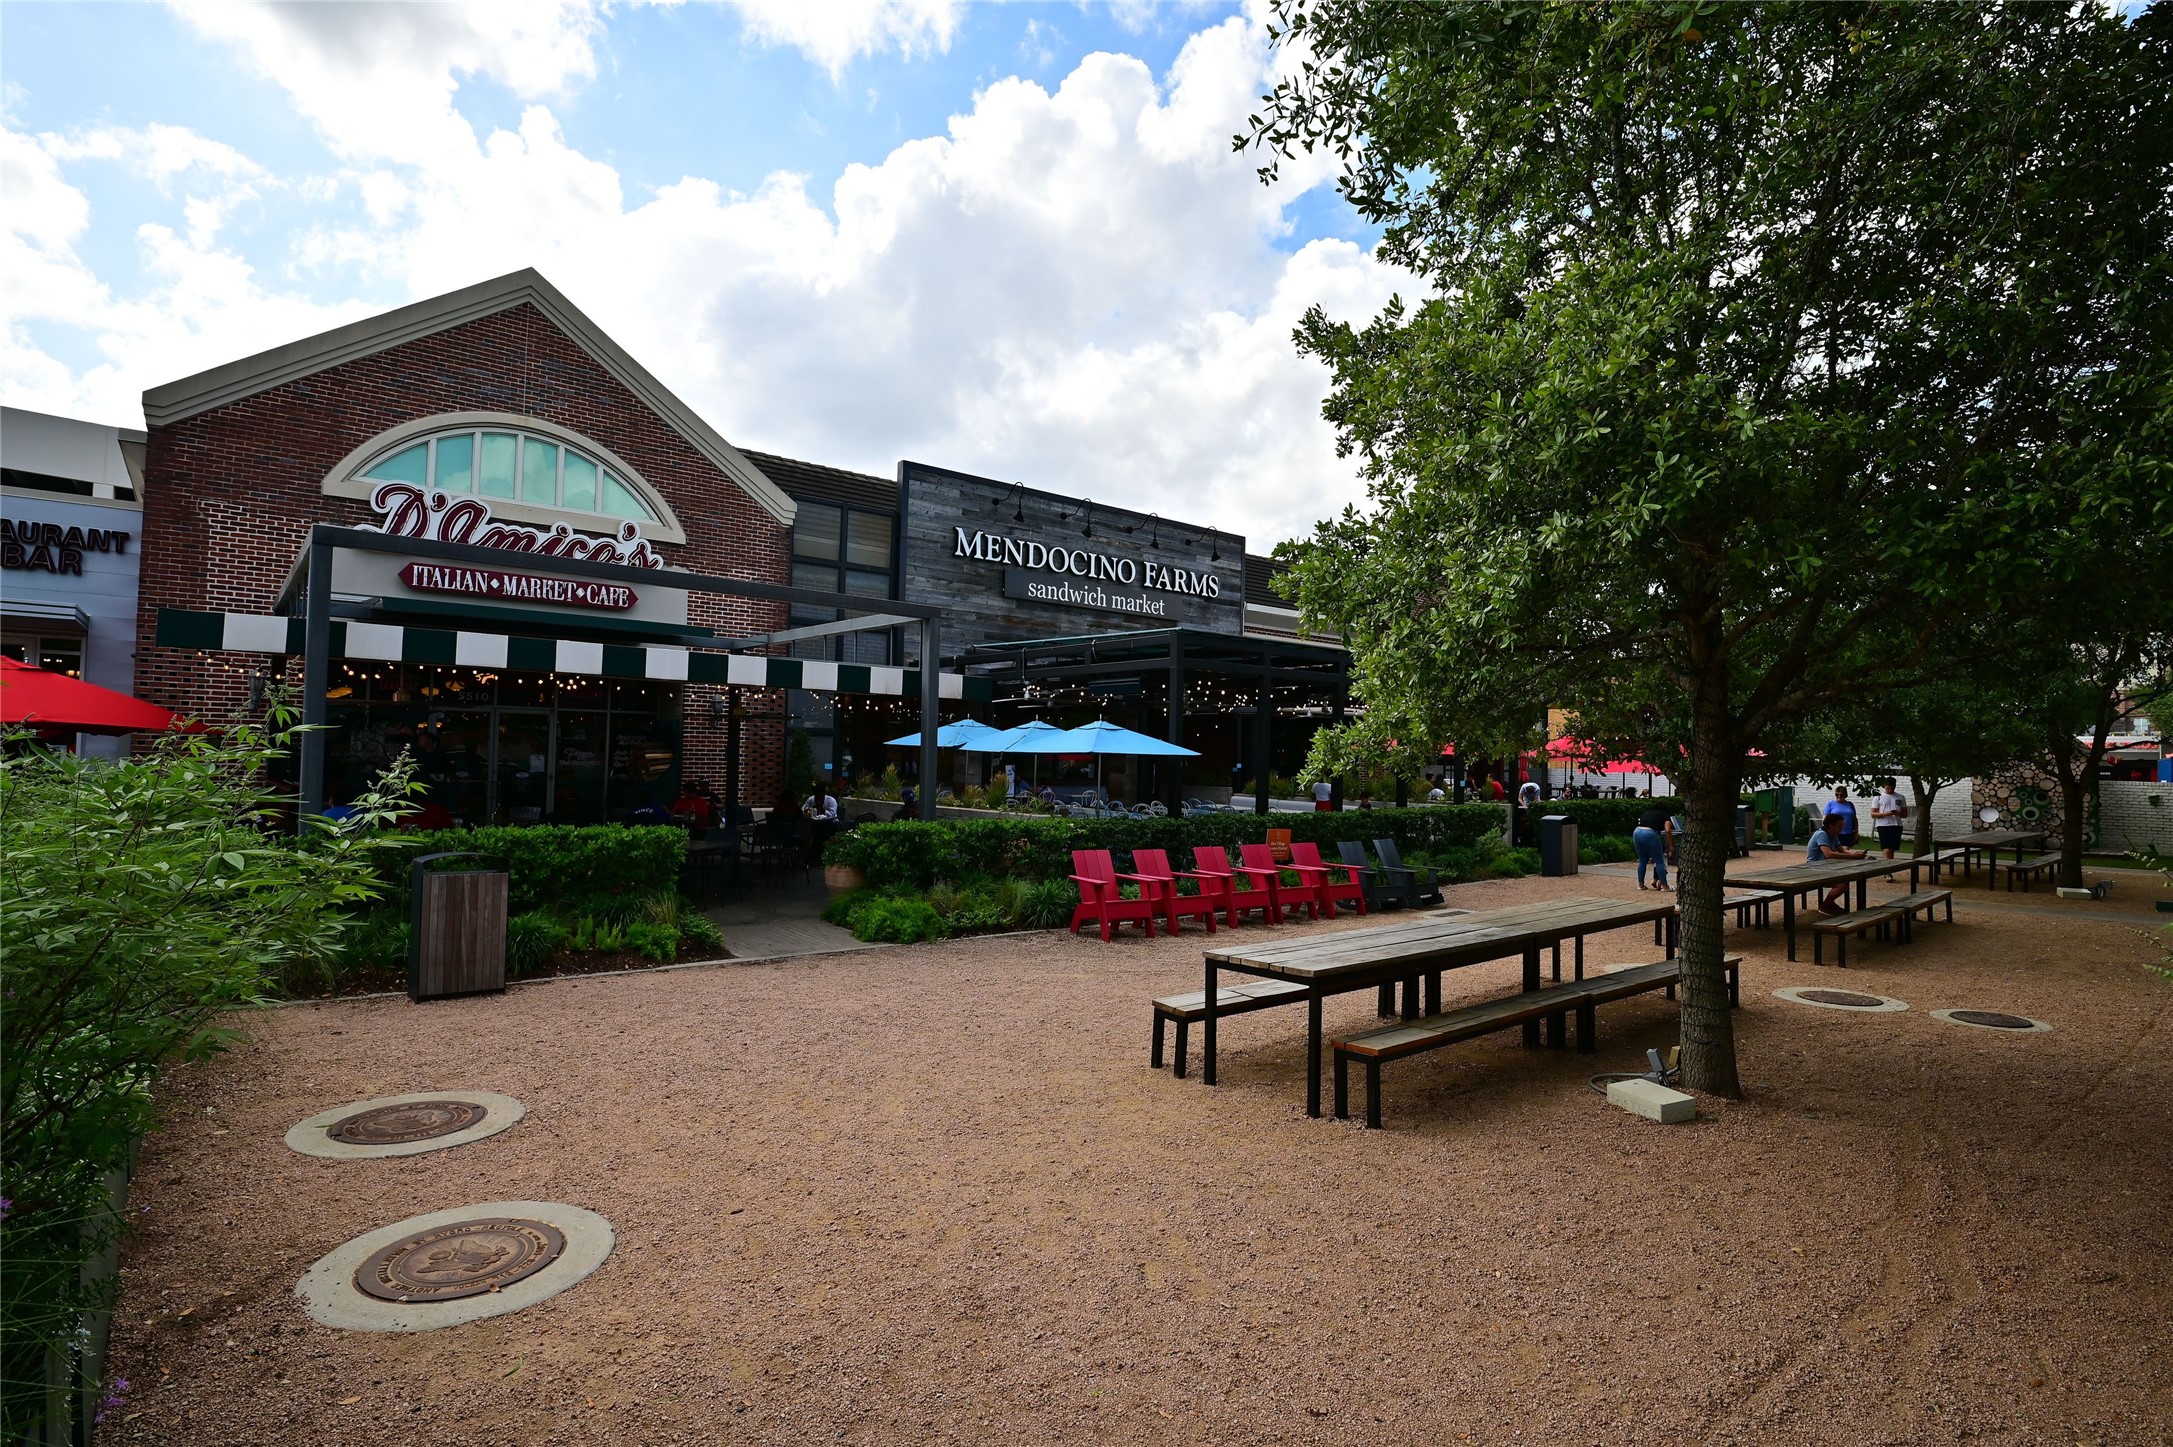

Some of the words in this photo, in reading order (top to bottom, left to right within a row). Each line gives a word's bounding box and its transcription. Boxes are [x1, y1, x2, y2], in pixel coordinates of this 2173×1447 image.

[0, 541, 84, 577] BAR
[954, 526, 1137, 584] MENDOCINO
[1143, 560, 1220, 599] FARMS
[411, 565, 489, 593] ITALIAN
[502, 574, 577, 603] MARKET
[586, 584, 630, 609] CAFE
[1027, 581, 1108, 608] sandwich
[1111, 593, 1166, 616] market
[457, 691, 490, 702] 5510
